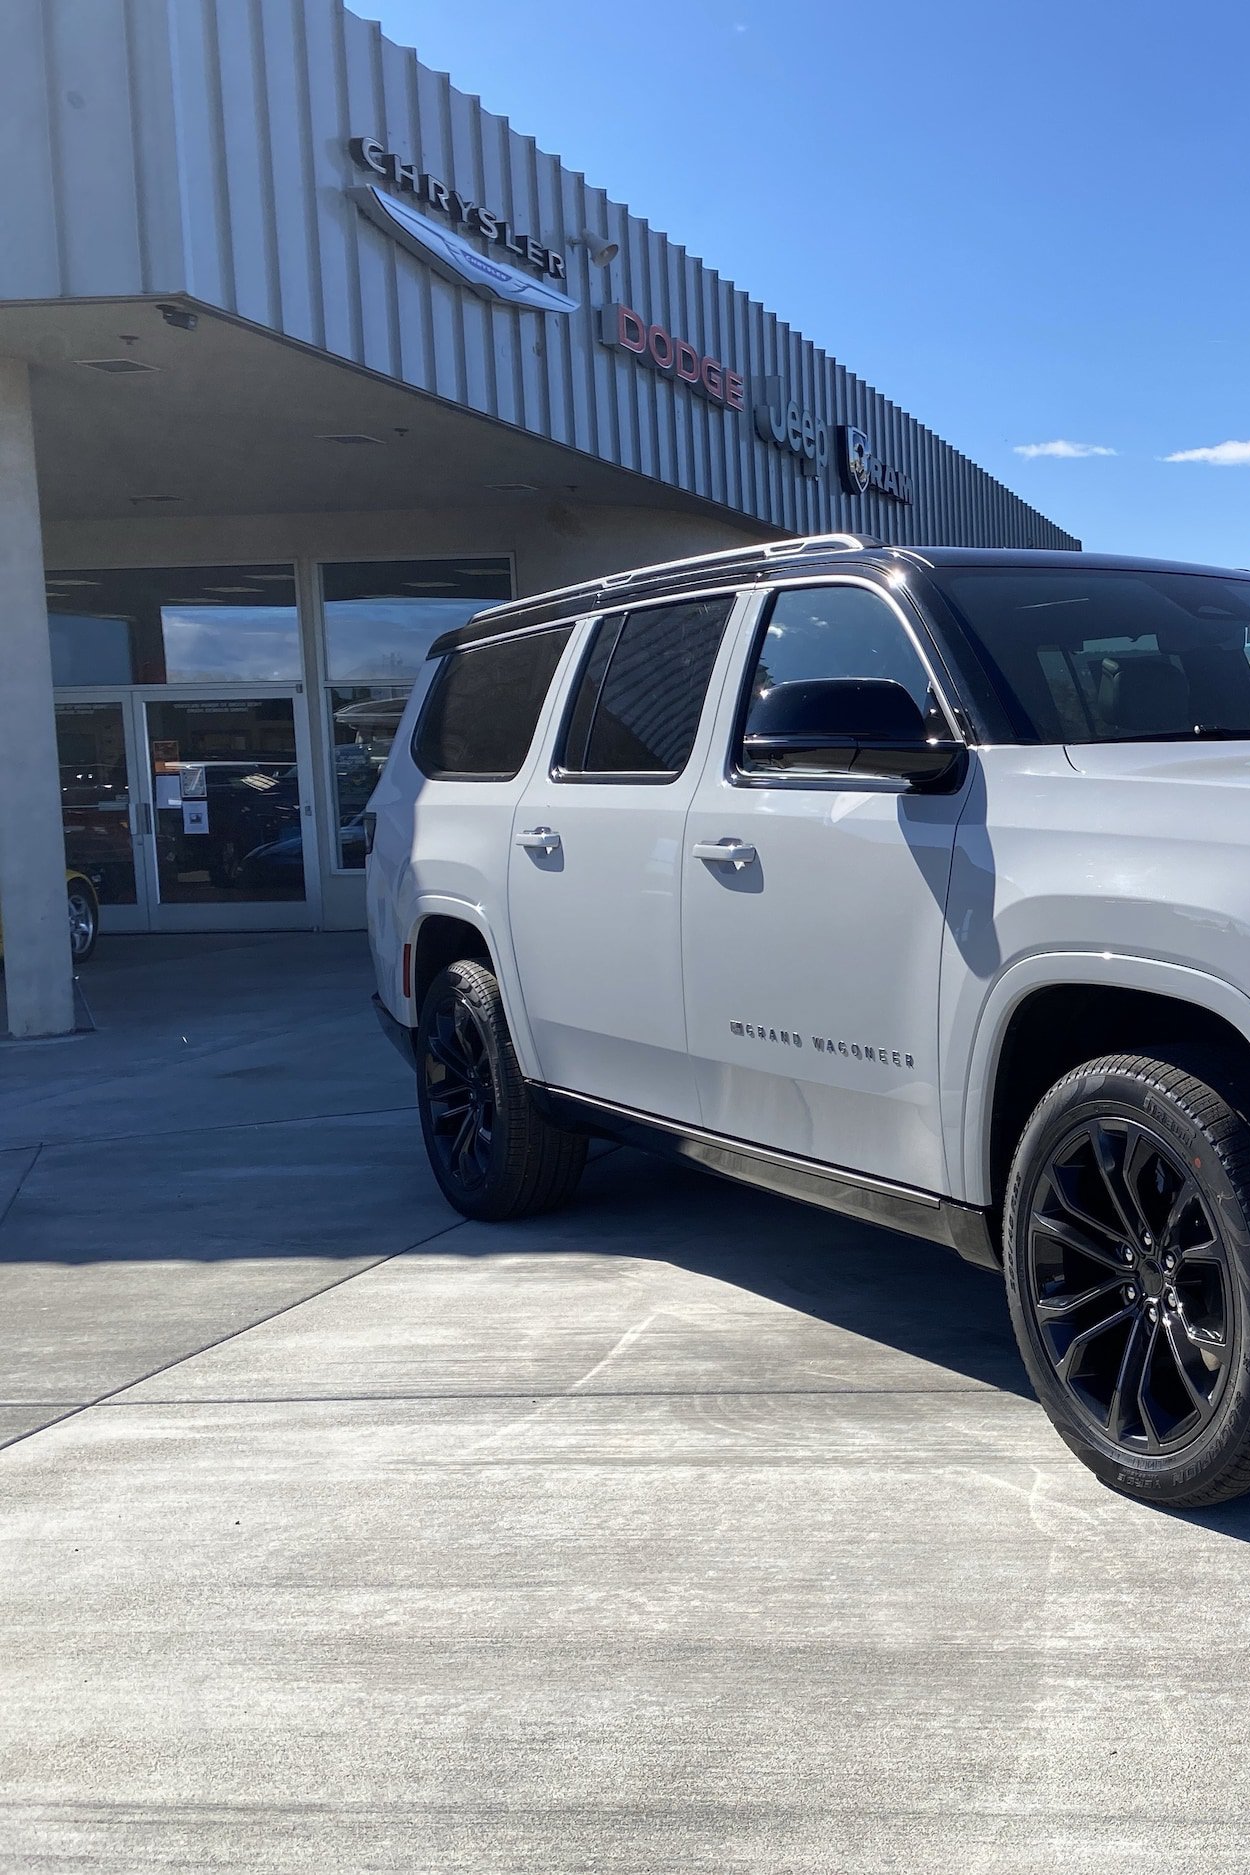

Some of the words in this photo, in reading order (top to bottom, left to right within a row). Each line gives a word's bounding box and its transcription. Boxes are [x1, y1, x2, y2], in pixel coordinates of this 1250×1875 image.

[361, 137, 566, 279] CHRYSLER
[465, 254, 507, 280] CHRYSLER
[616, 304, 744, 412] DODGE
[764, 376, 828, 477] Jeep
[868, 456, 914, 502] RAM
[746, 1023, 801, 1048] GRAND
[812, 1036, 915, 1069] WAGONEER
